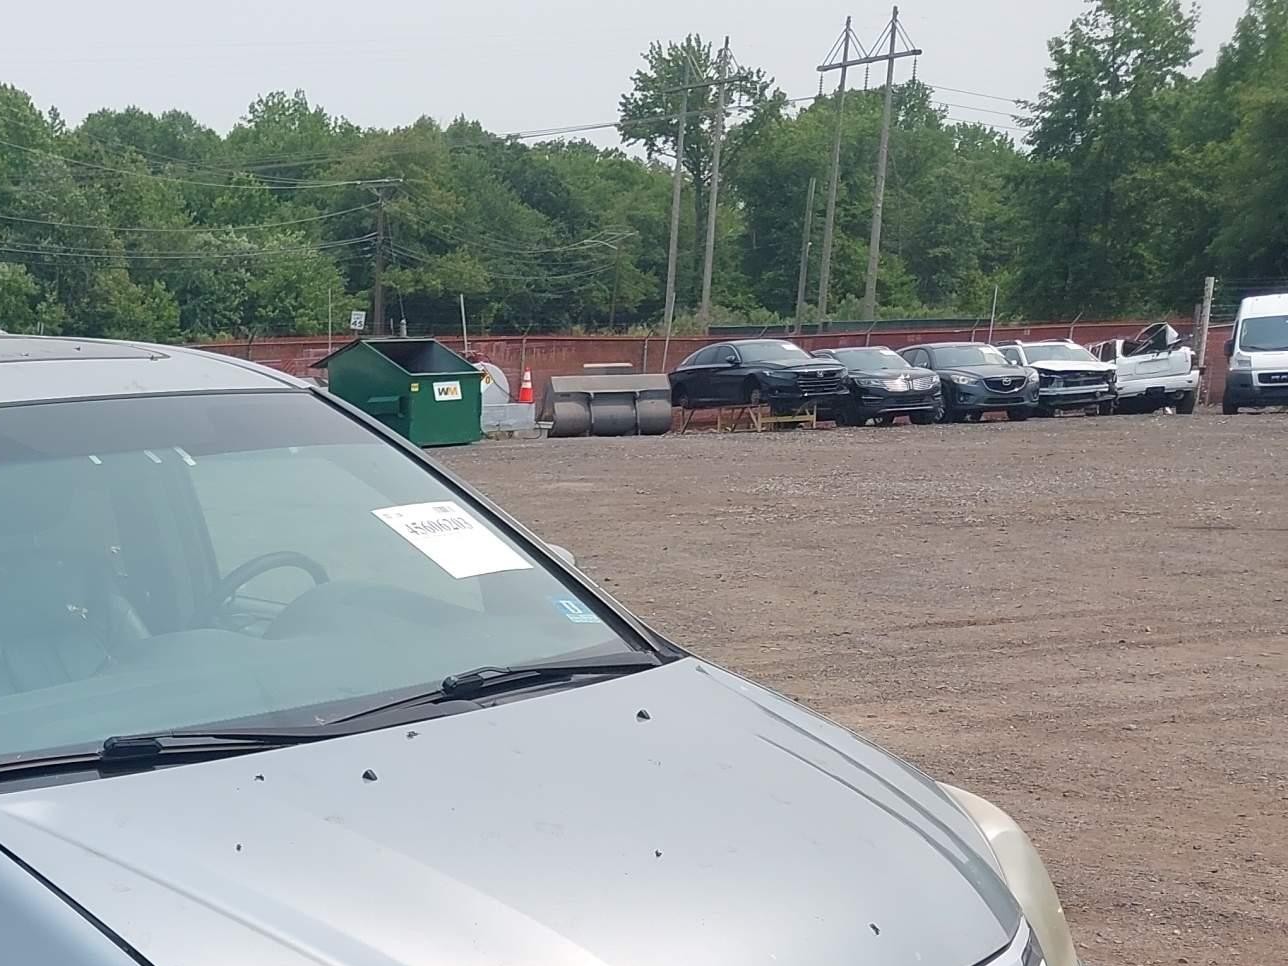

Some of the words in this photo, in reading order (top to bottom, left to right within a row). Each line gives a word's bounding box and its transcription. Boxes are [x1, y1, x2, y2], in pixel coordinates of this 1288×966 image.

[352, 320, 363, 328] 45
[438, 386, 458, 396] WM
[405, 517, 474, 536] 45606203
